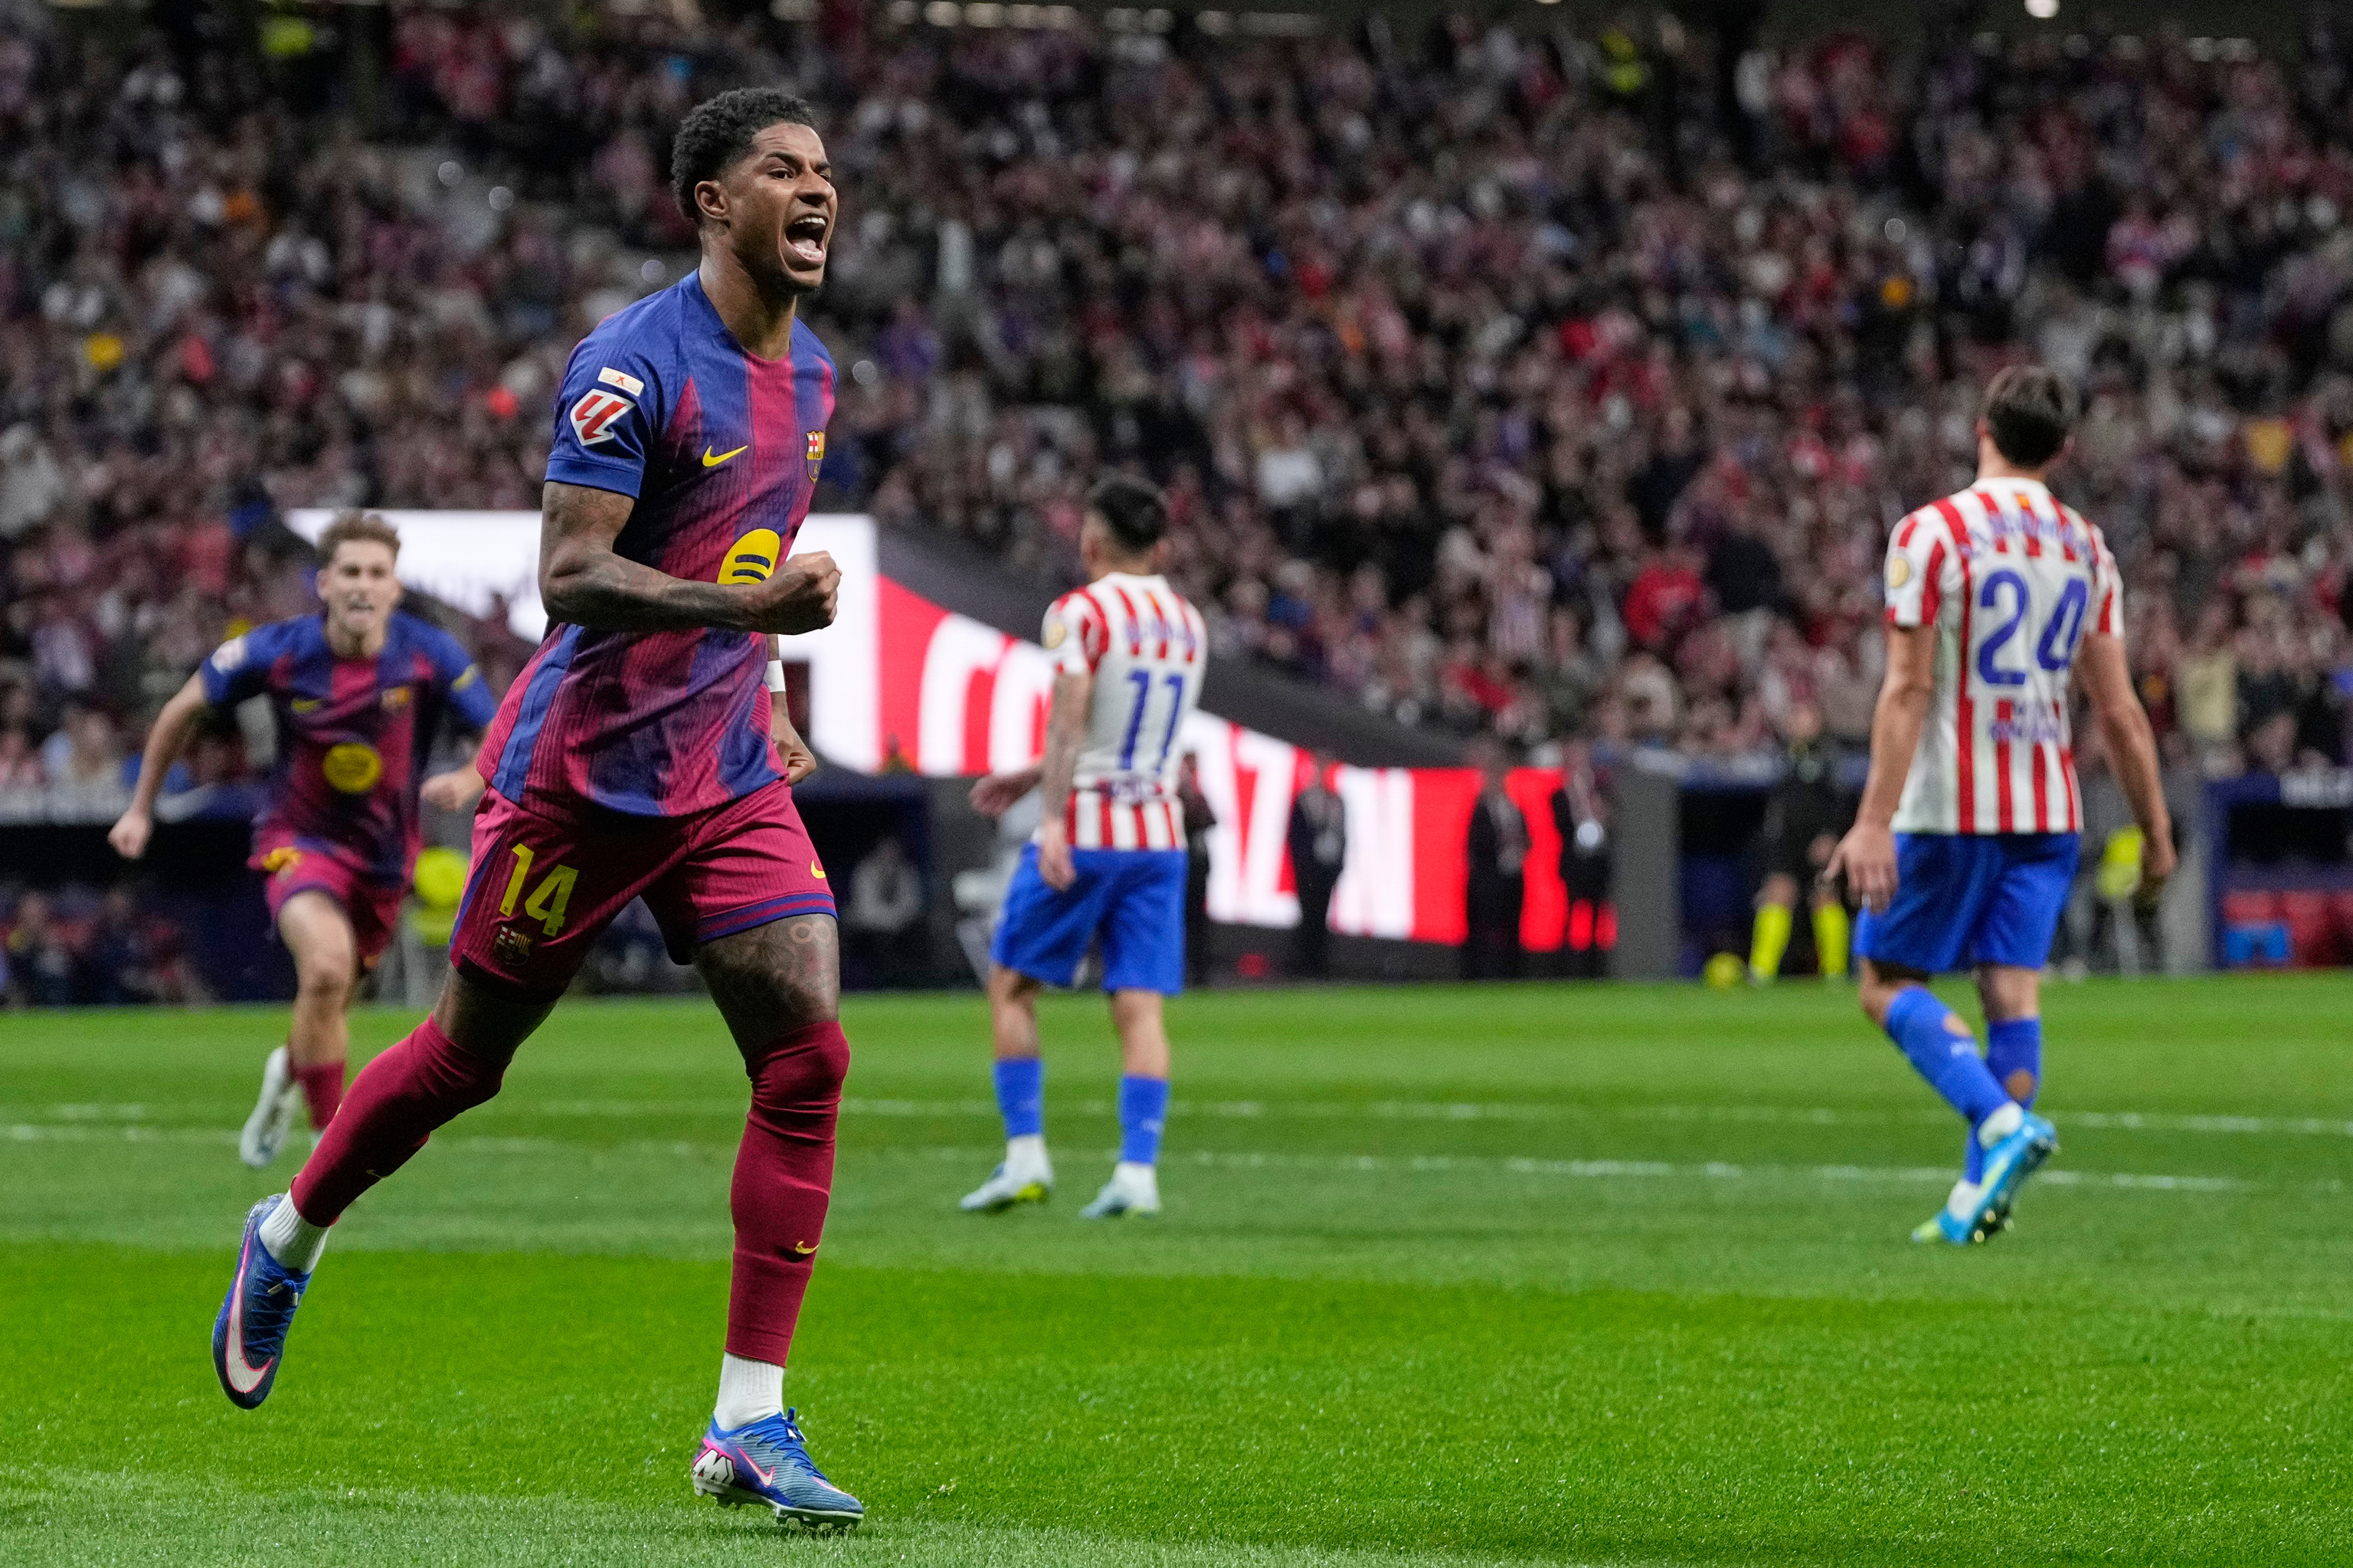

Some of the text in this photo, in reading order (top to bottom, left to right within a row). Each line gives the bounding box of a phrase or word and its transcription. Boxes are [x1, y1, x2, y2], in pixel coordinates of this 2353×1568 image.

[1978, 570, 2087, 685] 24
[1119, 669, 1185, 774] 11
[499, 843, 580, 938] 14
